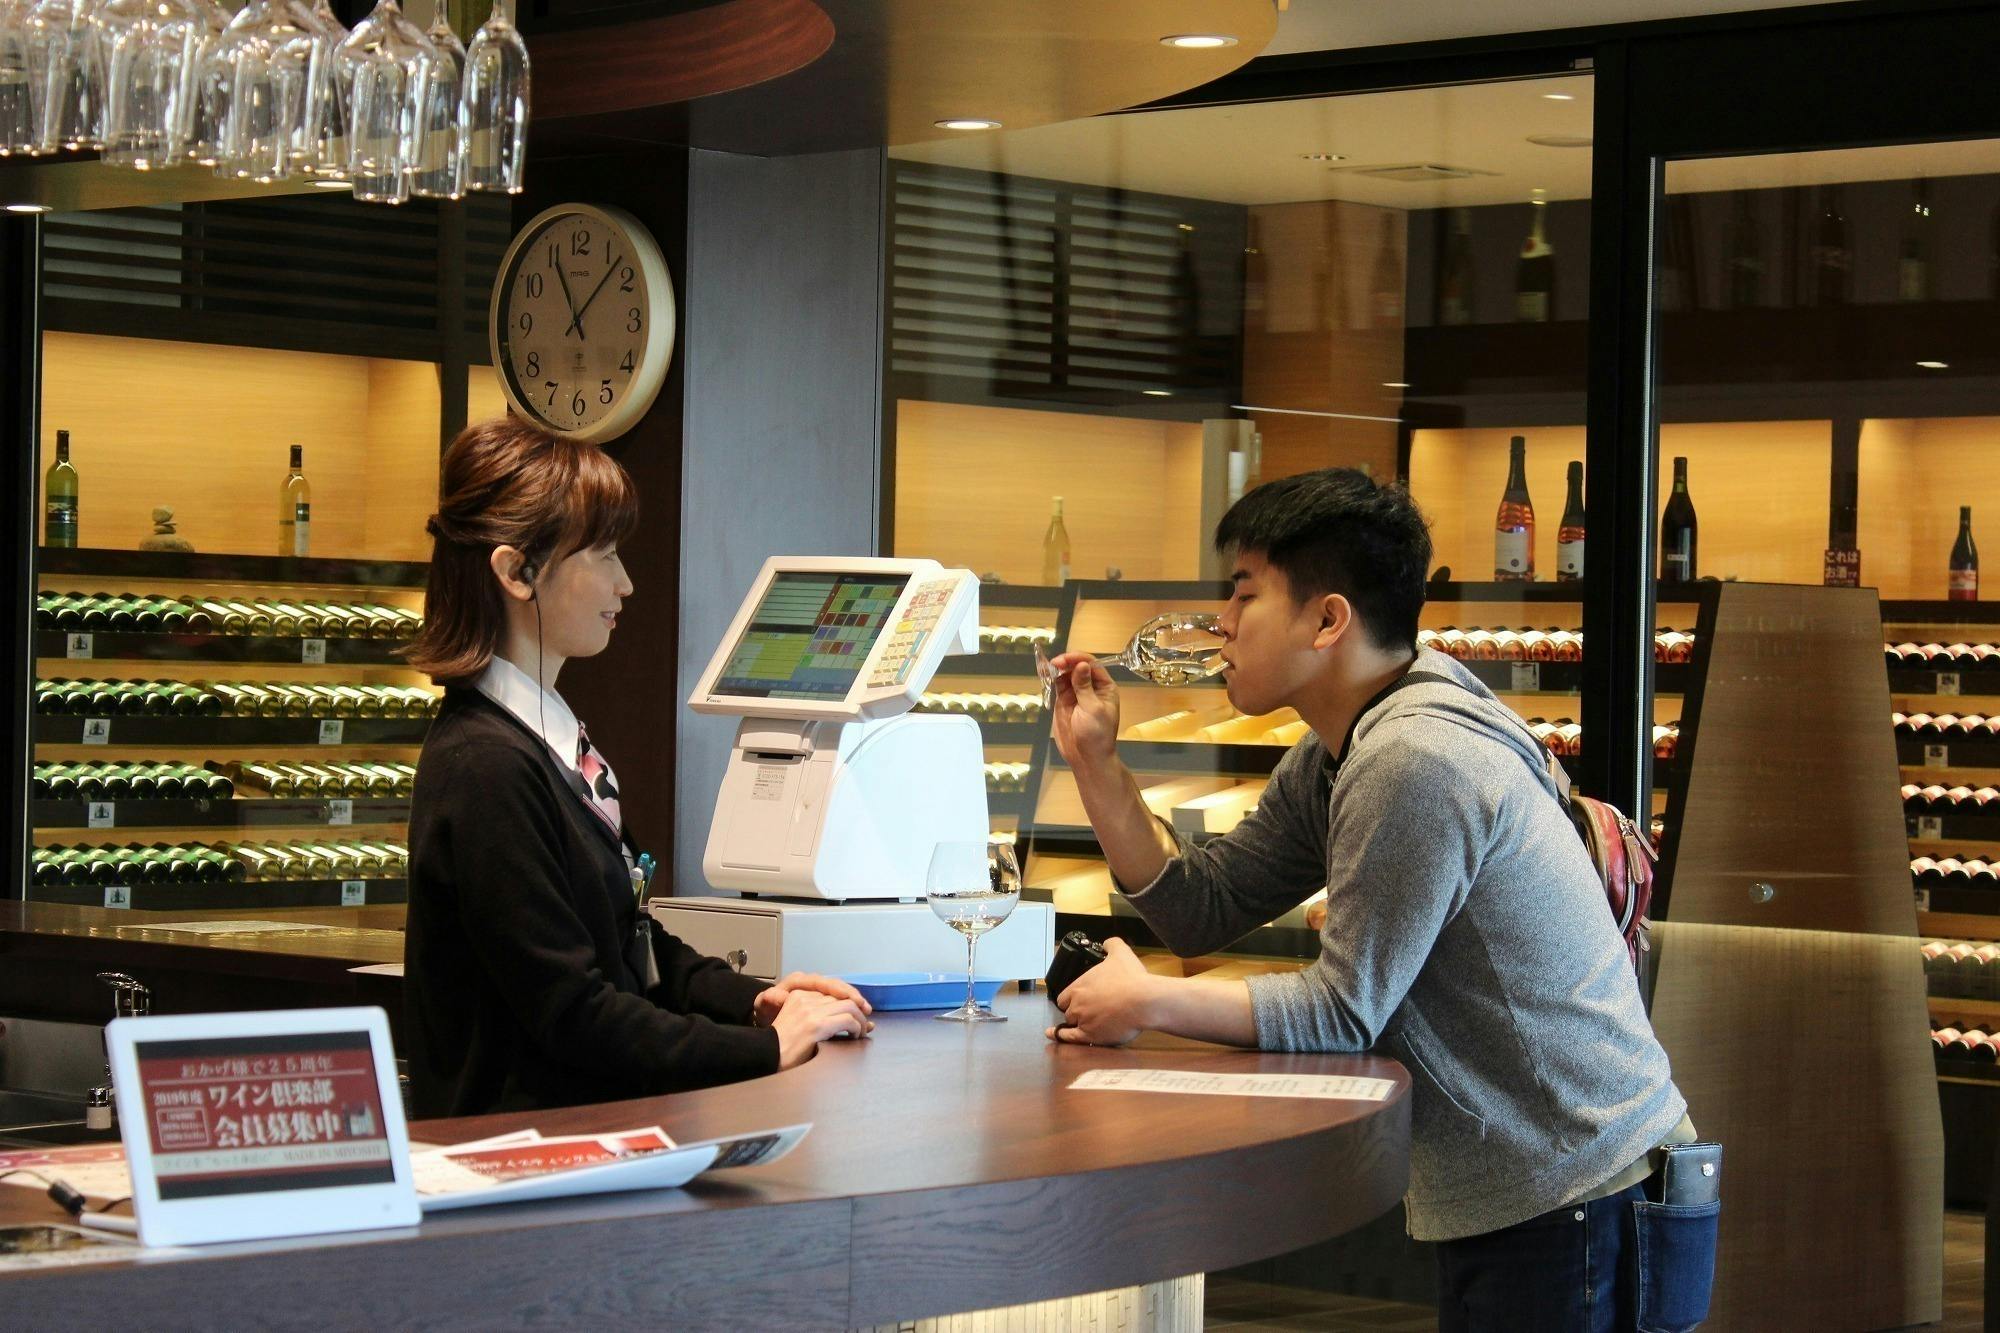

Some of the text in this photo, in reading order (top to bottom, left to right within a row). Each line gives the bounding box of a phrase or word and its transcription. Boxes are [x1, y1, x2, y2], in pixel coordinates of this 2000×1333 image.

[571, 230, 590, 256] 12
[606, 239, 610, 264] 1
[549, 244, 559, 268] 11
[526, 272, 543, 298] 10
[620, 267, 634, 293] 2
[520, 313, 532, 339] 9
[627, 308, 641, 333] 3
[526, 352, 540, 377] 8
[619, 349, 634, 373] 4
[544, 381, 559, 406] 7
[573, 389, 585, 416] 6
[600, 379, 613, 404] 5
[208, 1078, 335, 1109] ワイン倶楽部
[215, 1109, 341, 1147] 会員募集中
[317, 1147, 332, 1159] IN
